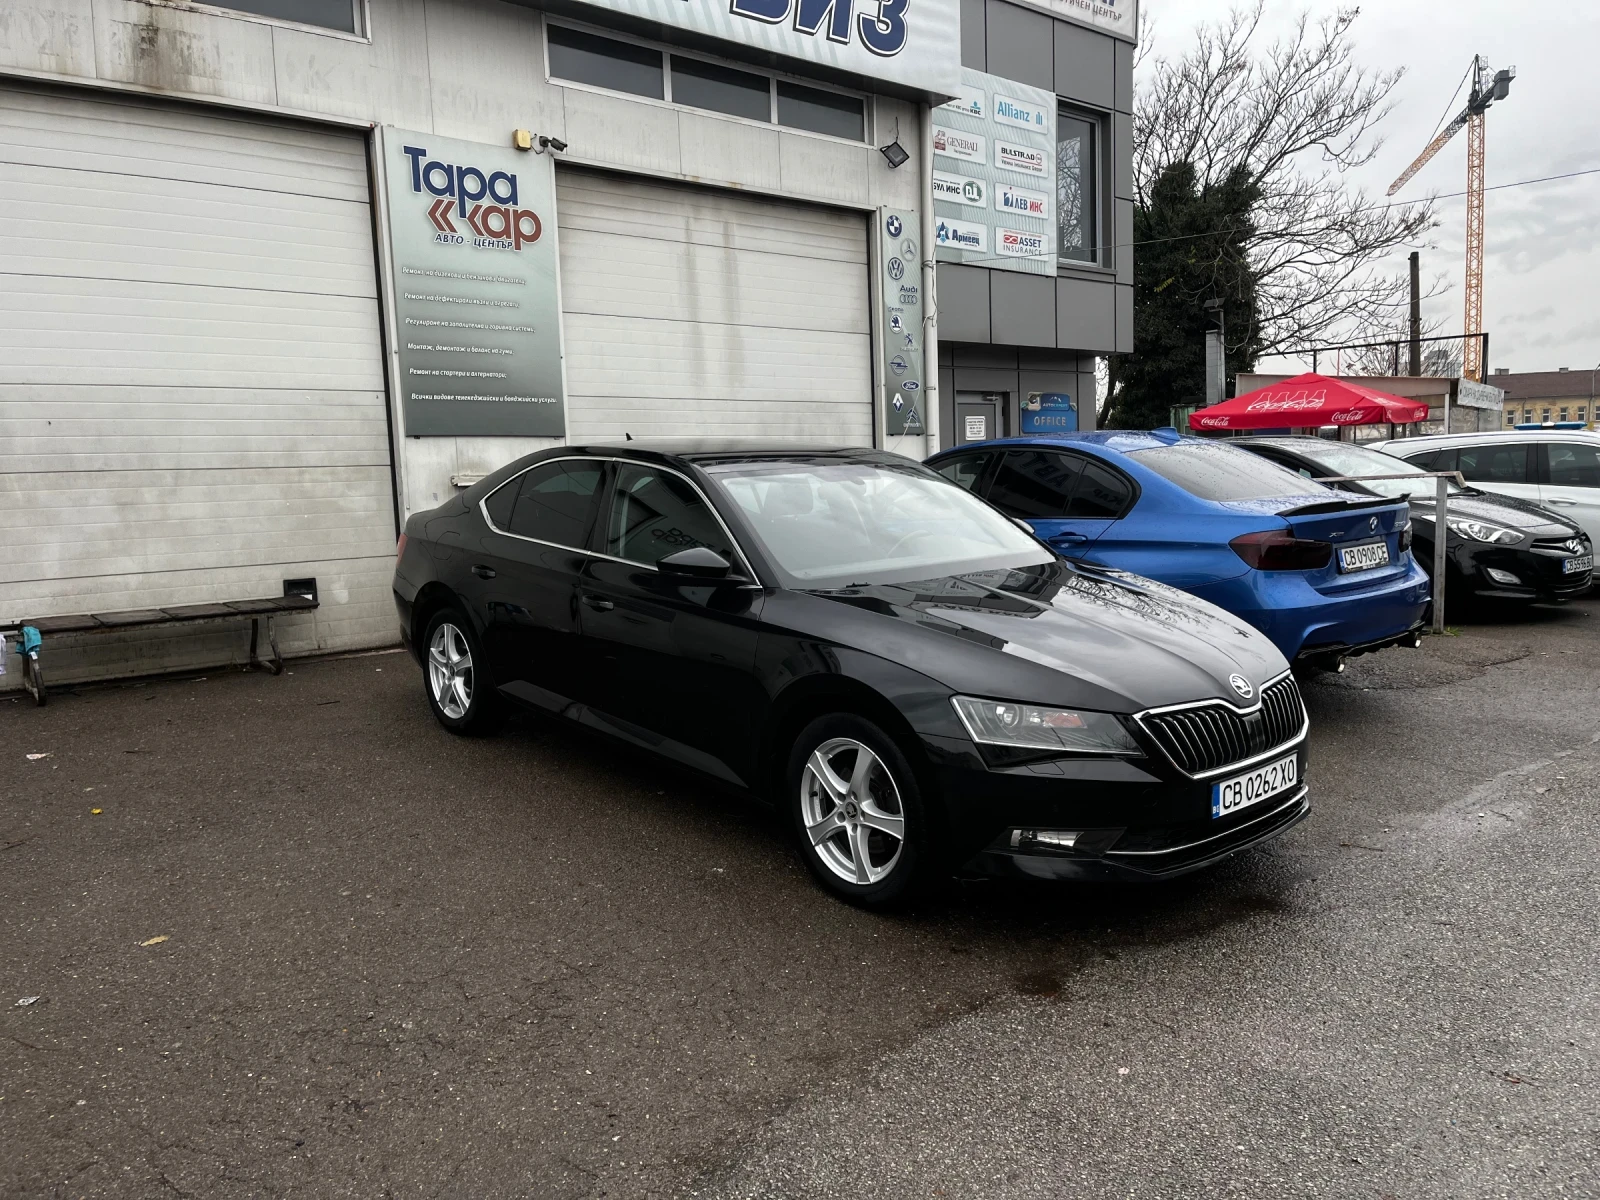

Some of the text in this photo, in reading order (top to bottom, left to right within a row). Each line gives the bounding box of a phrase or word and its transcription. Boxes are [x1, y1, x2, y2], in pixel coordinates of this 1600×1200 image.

[1093, 4, 1122, 21] ЦЕНТЪР
[997, 101, 1030, 123] Allianz
[947, 137, 978, 152] GENERALI
[1001, 147, 1035, 161] BULSTRAD
[403, 145, 519, 218] Тара
[946, 184, 961, 195] ИНС
[1014, 197, 1028, 211] ЛЕВ
[1029, 200, 1043, 214] ИНС
[435, 233, 464, 245] АВТО
[473, 239, 513, 250] ЦЕНТЪР
[952, 228, 980, 247] Армеец
[1019, 236, 1042, 249] ASSET
[1003, 244, 1042, 257] INSURANCE
[900, 284, 918, 293] Audi
[407, 342, 435, 351] Монтаж,
[435, 343, 466, 352] демонтаж
[409, 367, 432, 375] Ремонт
[411, 392, 433, 400] Всички
[433, 393, 455, 401] видове
[1034, 416, 1066, 426] OFFICE
[1344, 549, 1357, 566] CB
[1357, 546, 1377, 564] 0908
[1377, 544, 1388, 561] CE
[1222, 758, 1295, 810] CB 0262 XO
